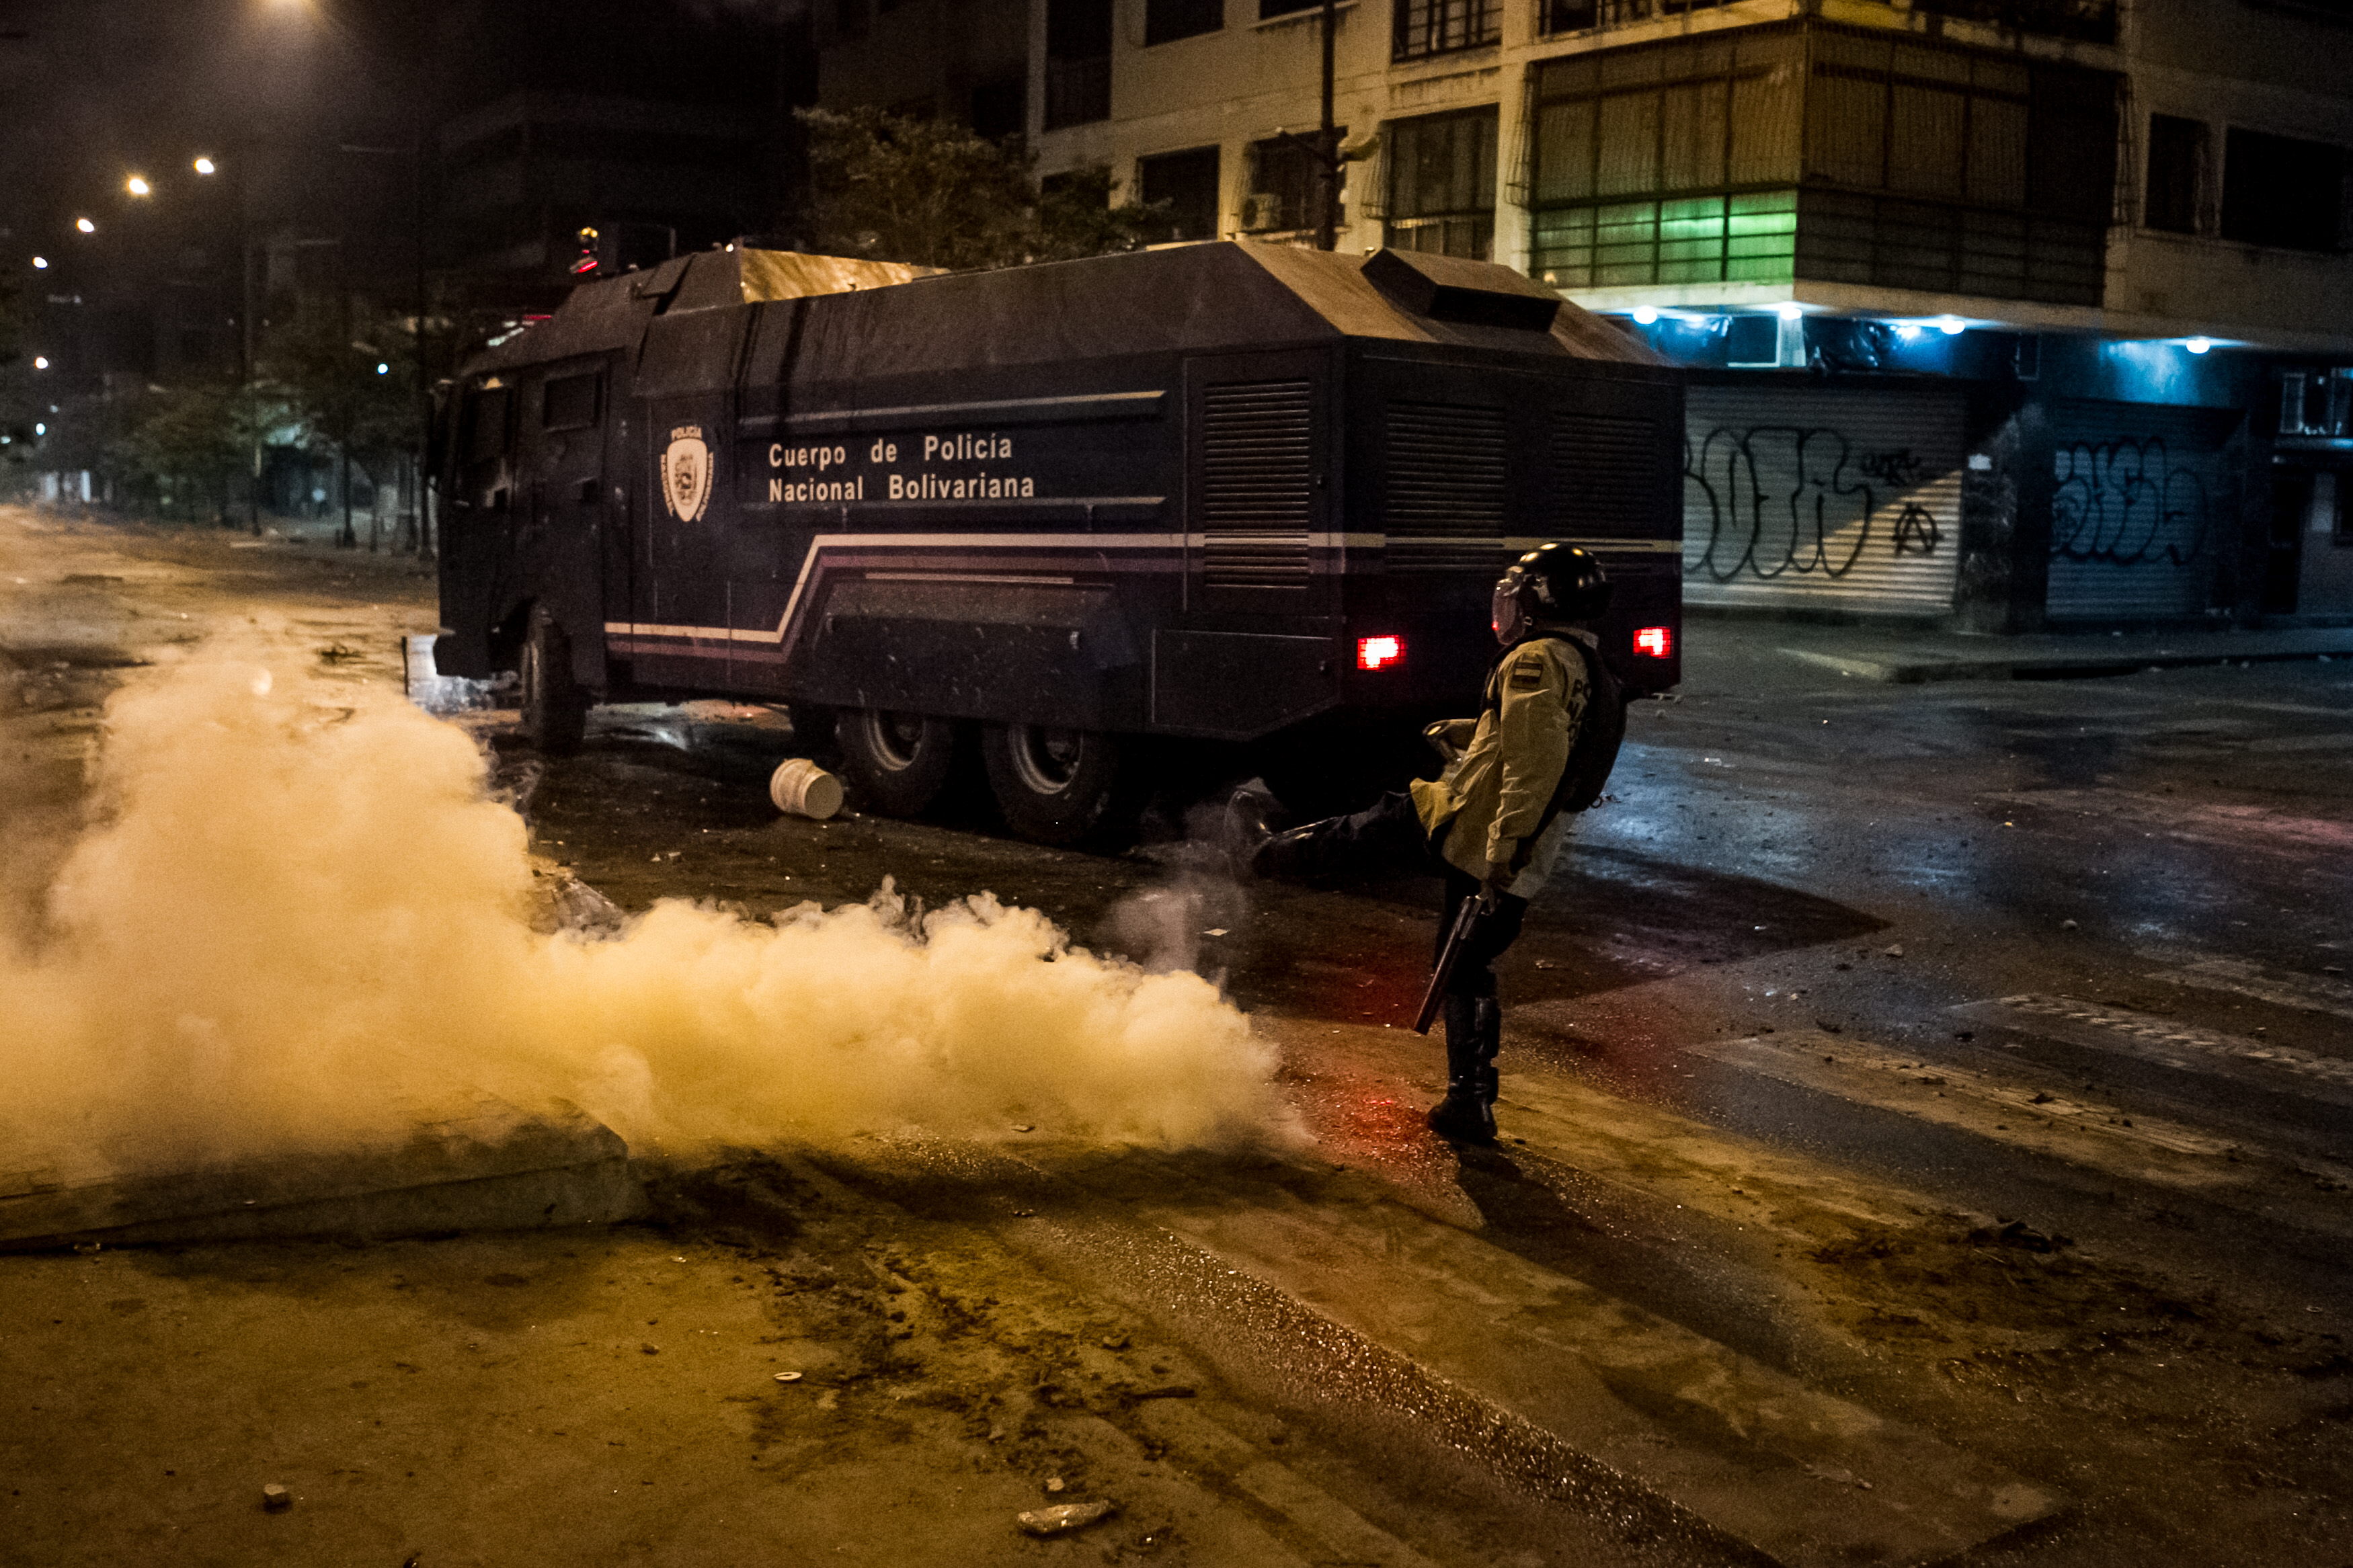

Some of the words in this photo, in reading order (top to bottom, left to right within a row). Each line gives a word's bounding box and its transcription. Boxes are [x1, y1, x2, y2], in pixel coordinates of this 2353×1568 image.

[768, 443, 846, 471] Cuerpo
[871, 438, 898, 462] de
[924, 433, 1012, 461] Policía
[769, 475, 863, 502] Nacional
[889, 472, 1035, 500] Bolivariana
